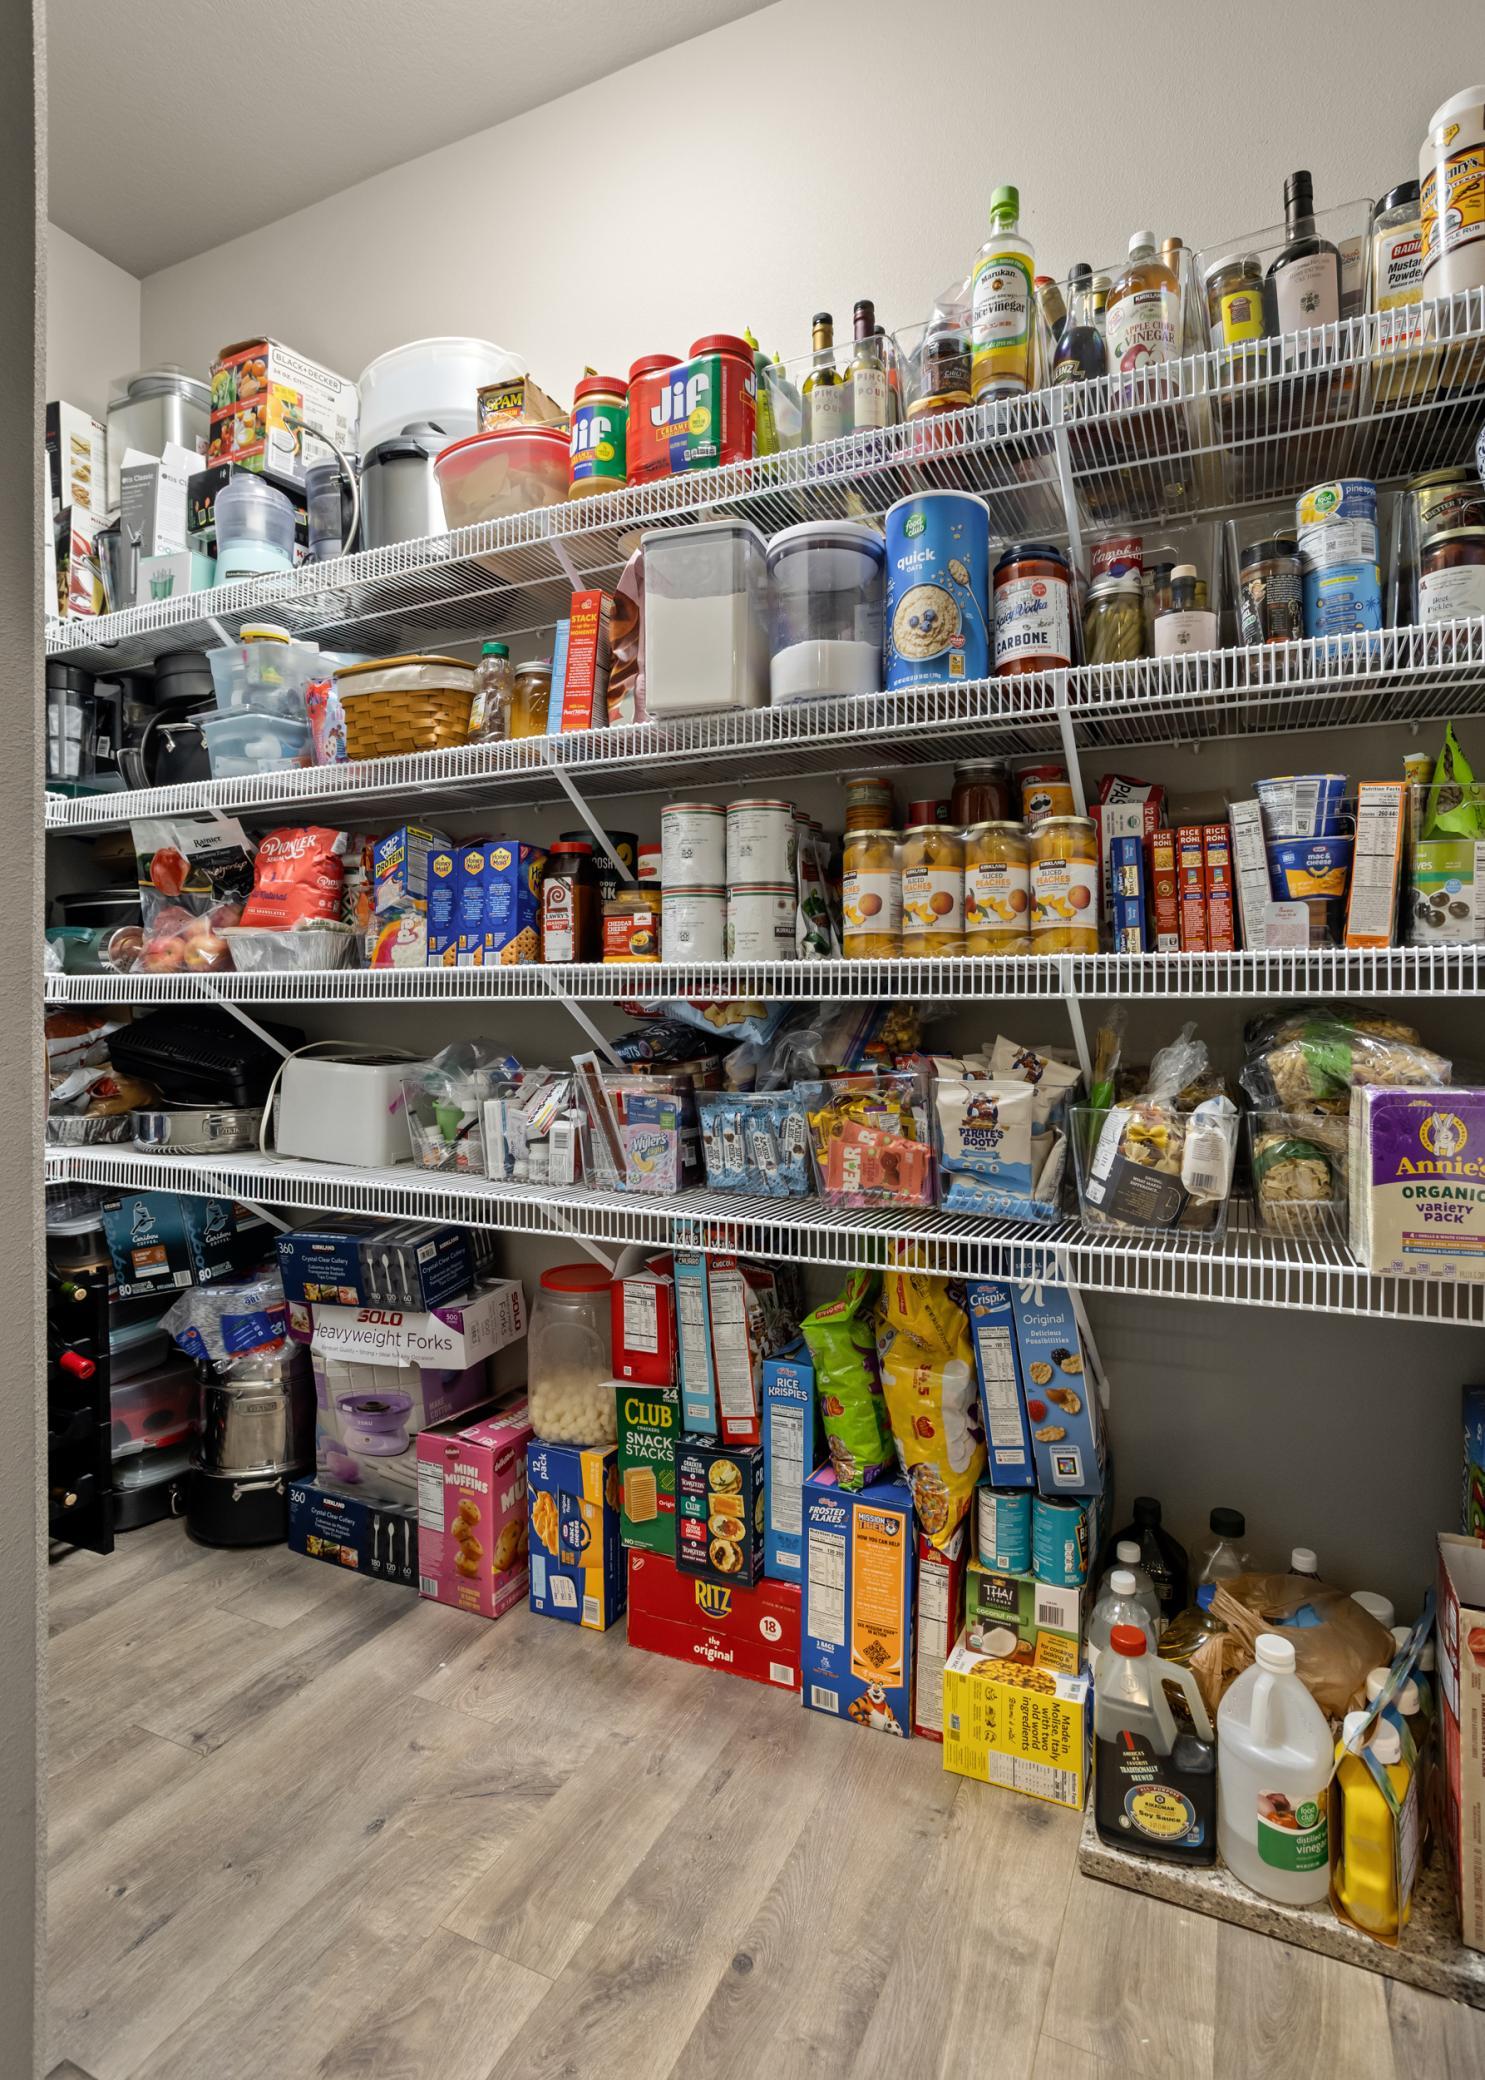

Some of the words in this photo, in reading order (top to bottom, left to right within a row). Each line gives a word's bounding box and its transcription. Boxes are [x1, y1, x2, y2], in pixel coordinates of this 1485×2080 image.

[1462, 224, 1481, 234] RUB
[988, 301, 1025, 315] Vinegar
[1125, 330, 1175, 344] VINEGAR
[275, 352, 339, 391] BLACK+DECKER
[486, 393, 522, 413] SPAM
[651, 373, 710, 427] Jif
[1426, 501, 1456, 519] BETTER
[905, 517, 924, 530] food
[908, 525, 925, 537] club
[897, 548, 936, 570] quick
[906, 564, 923, 573] OATS
[571, 614, 597, 624] STACK
[997, 632, 1048, 655] CARBONE
[194, 835, 222, 848] Rainier
[376, 848, 404, 876] PROTEIN
[976, 879, 1011, 887] PEACHES
[1036, 876, 1071, 885] PEACHES
[959, 1128, 1004, 1140] PIRATE'S
[964, 1137, 999, 1146] BOOTY
[632, 1134, 667, 1152] Wyler's
[843, 1147, 861, 1192] BEAR
[1402, 1186, 1485, 1202] ORGANIC
[278, 1243, 294, 1255] 360
[199, 1268, 212, 1281] 80
[119, 1285, 132, 1296] 80
[970, 1290, 1006, 1307] Crispix
[357, 1310, 403, 1327] SOLO
[511, 1291, 522, 1331] SOLO
[1023, 1314, 1065, 1326] Original
[314, 1322, 402, 1348] Heavyweight
[408, 1332, 452, 1350] Forks
[1025, 1337, 1069, 1345] Possibilities
[777, 1378, 799, 1390] RICE
[663, 1389, 678, 1400] 24
[768, 1386, 808, 1401] KRISPIES
[625, 1398, 673, 1427] CLUB
[626, 1432, 673, 1449] SNACK
[626, 1443, 674, 1462] STACKS
[454, 1463, 479, 1478] MINI
[533, 1460, 541, 1472] 12
[541, 1453, 549, 1480] pack
[445, 1474, 489, 1494] MUFFINS
[290, 1489, 305, 1504] 360
[323, 1498, 345, 1509] KIRKLAND
[809, 1506, 846, 1516] FROSTED
[810, 1513, 842, 1523] FLAKES
[858, 1513, 885, 1524] MISSION
[403, 1567, 411, 1575] 60
[695, 1579, 732, 1613] RITZ
[983, 1584, 1013, 1600] THAI
[976, 1607, 1005, 1620] coconut
[1006, 1612, 1021, 1622] milk
[764, 1620, 776, 1633] 18
[709, 1636, 720, 1646] the
[694, 1643, 734, 1663] original
[1021, 1697, 1031, 1751] ingredients
[1042, 1707, 1050, 1730] with
[1052, 1702, 1061, 1739] Molise,
[1062, 1715, 1071, 1744] Made
[1032, 1724, 1041, 1751] world
[1050, 1740, 1058, 1762] Italy
[1062, 1744, 1068, 1754] in
[1120, 1765, 1158, 1774] TRADITIONALLY
[1145, 1801, 1175, 1812] KIKKOMAN
[1300, 1806, 1315, 1814] food
[1138, 1809, 1154, 1819] Soy
[1156, 1813, 1181, 1822] Sauce
